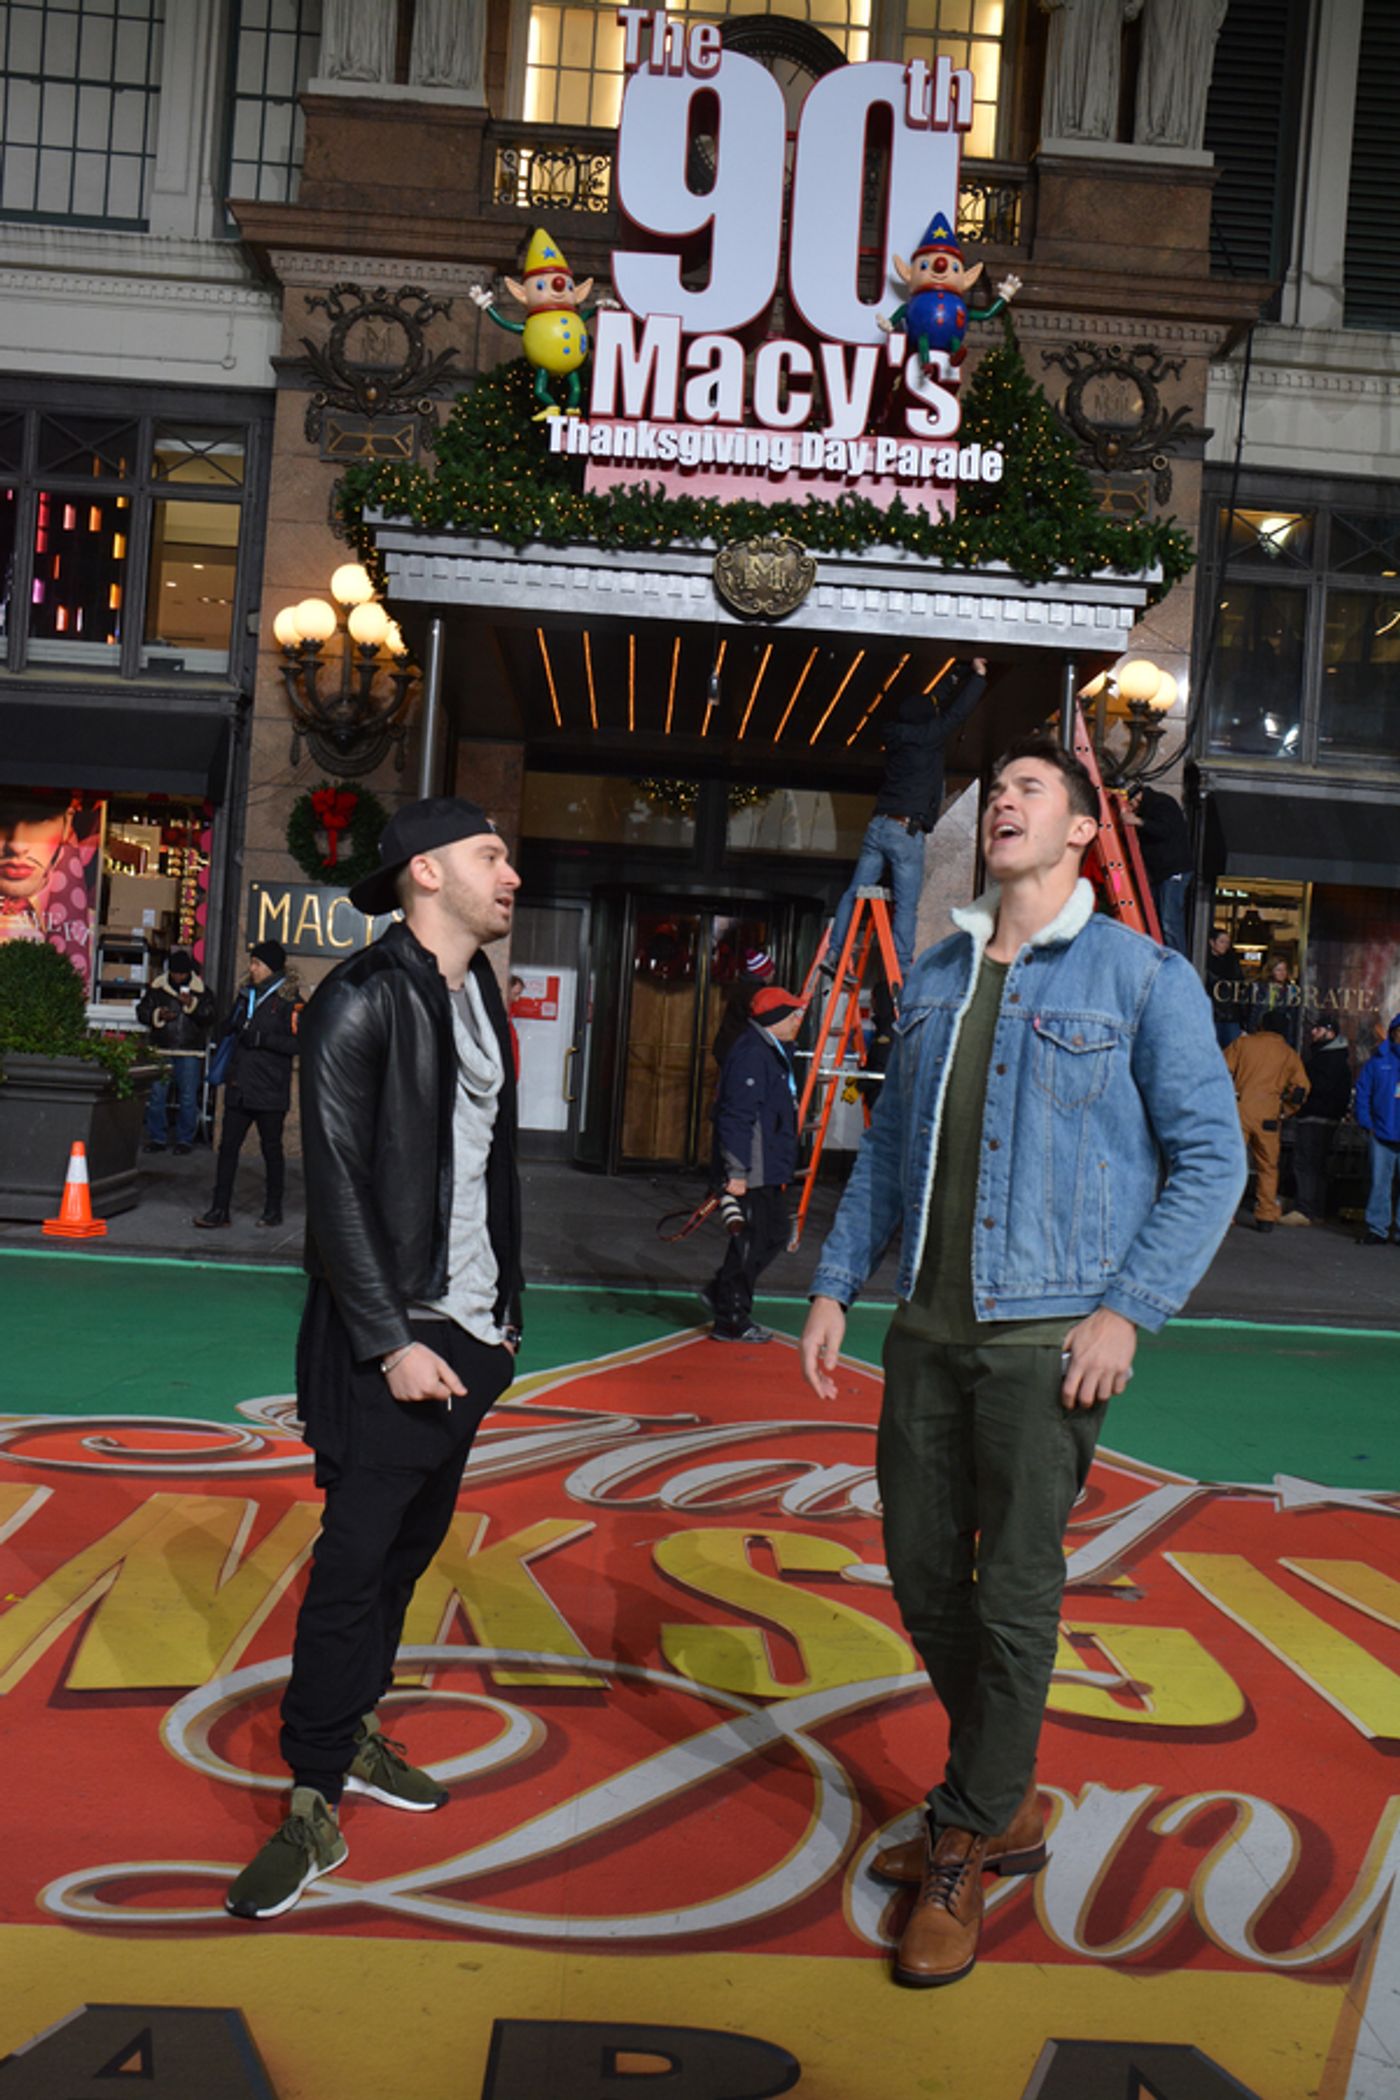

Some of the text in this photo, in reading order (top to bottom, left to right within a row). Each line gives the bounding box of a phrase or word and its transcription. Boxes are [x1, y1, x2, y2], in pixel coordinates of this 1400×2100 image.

[617, 7, 722, 77] The
[589, 310, 962, 440] Macy's
[546, 415, 1004, 483] Thanksgiving Day Parade
[257, 890, 405, 949] MAC
